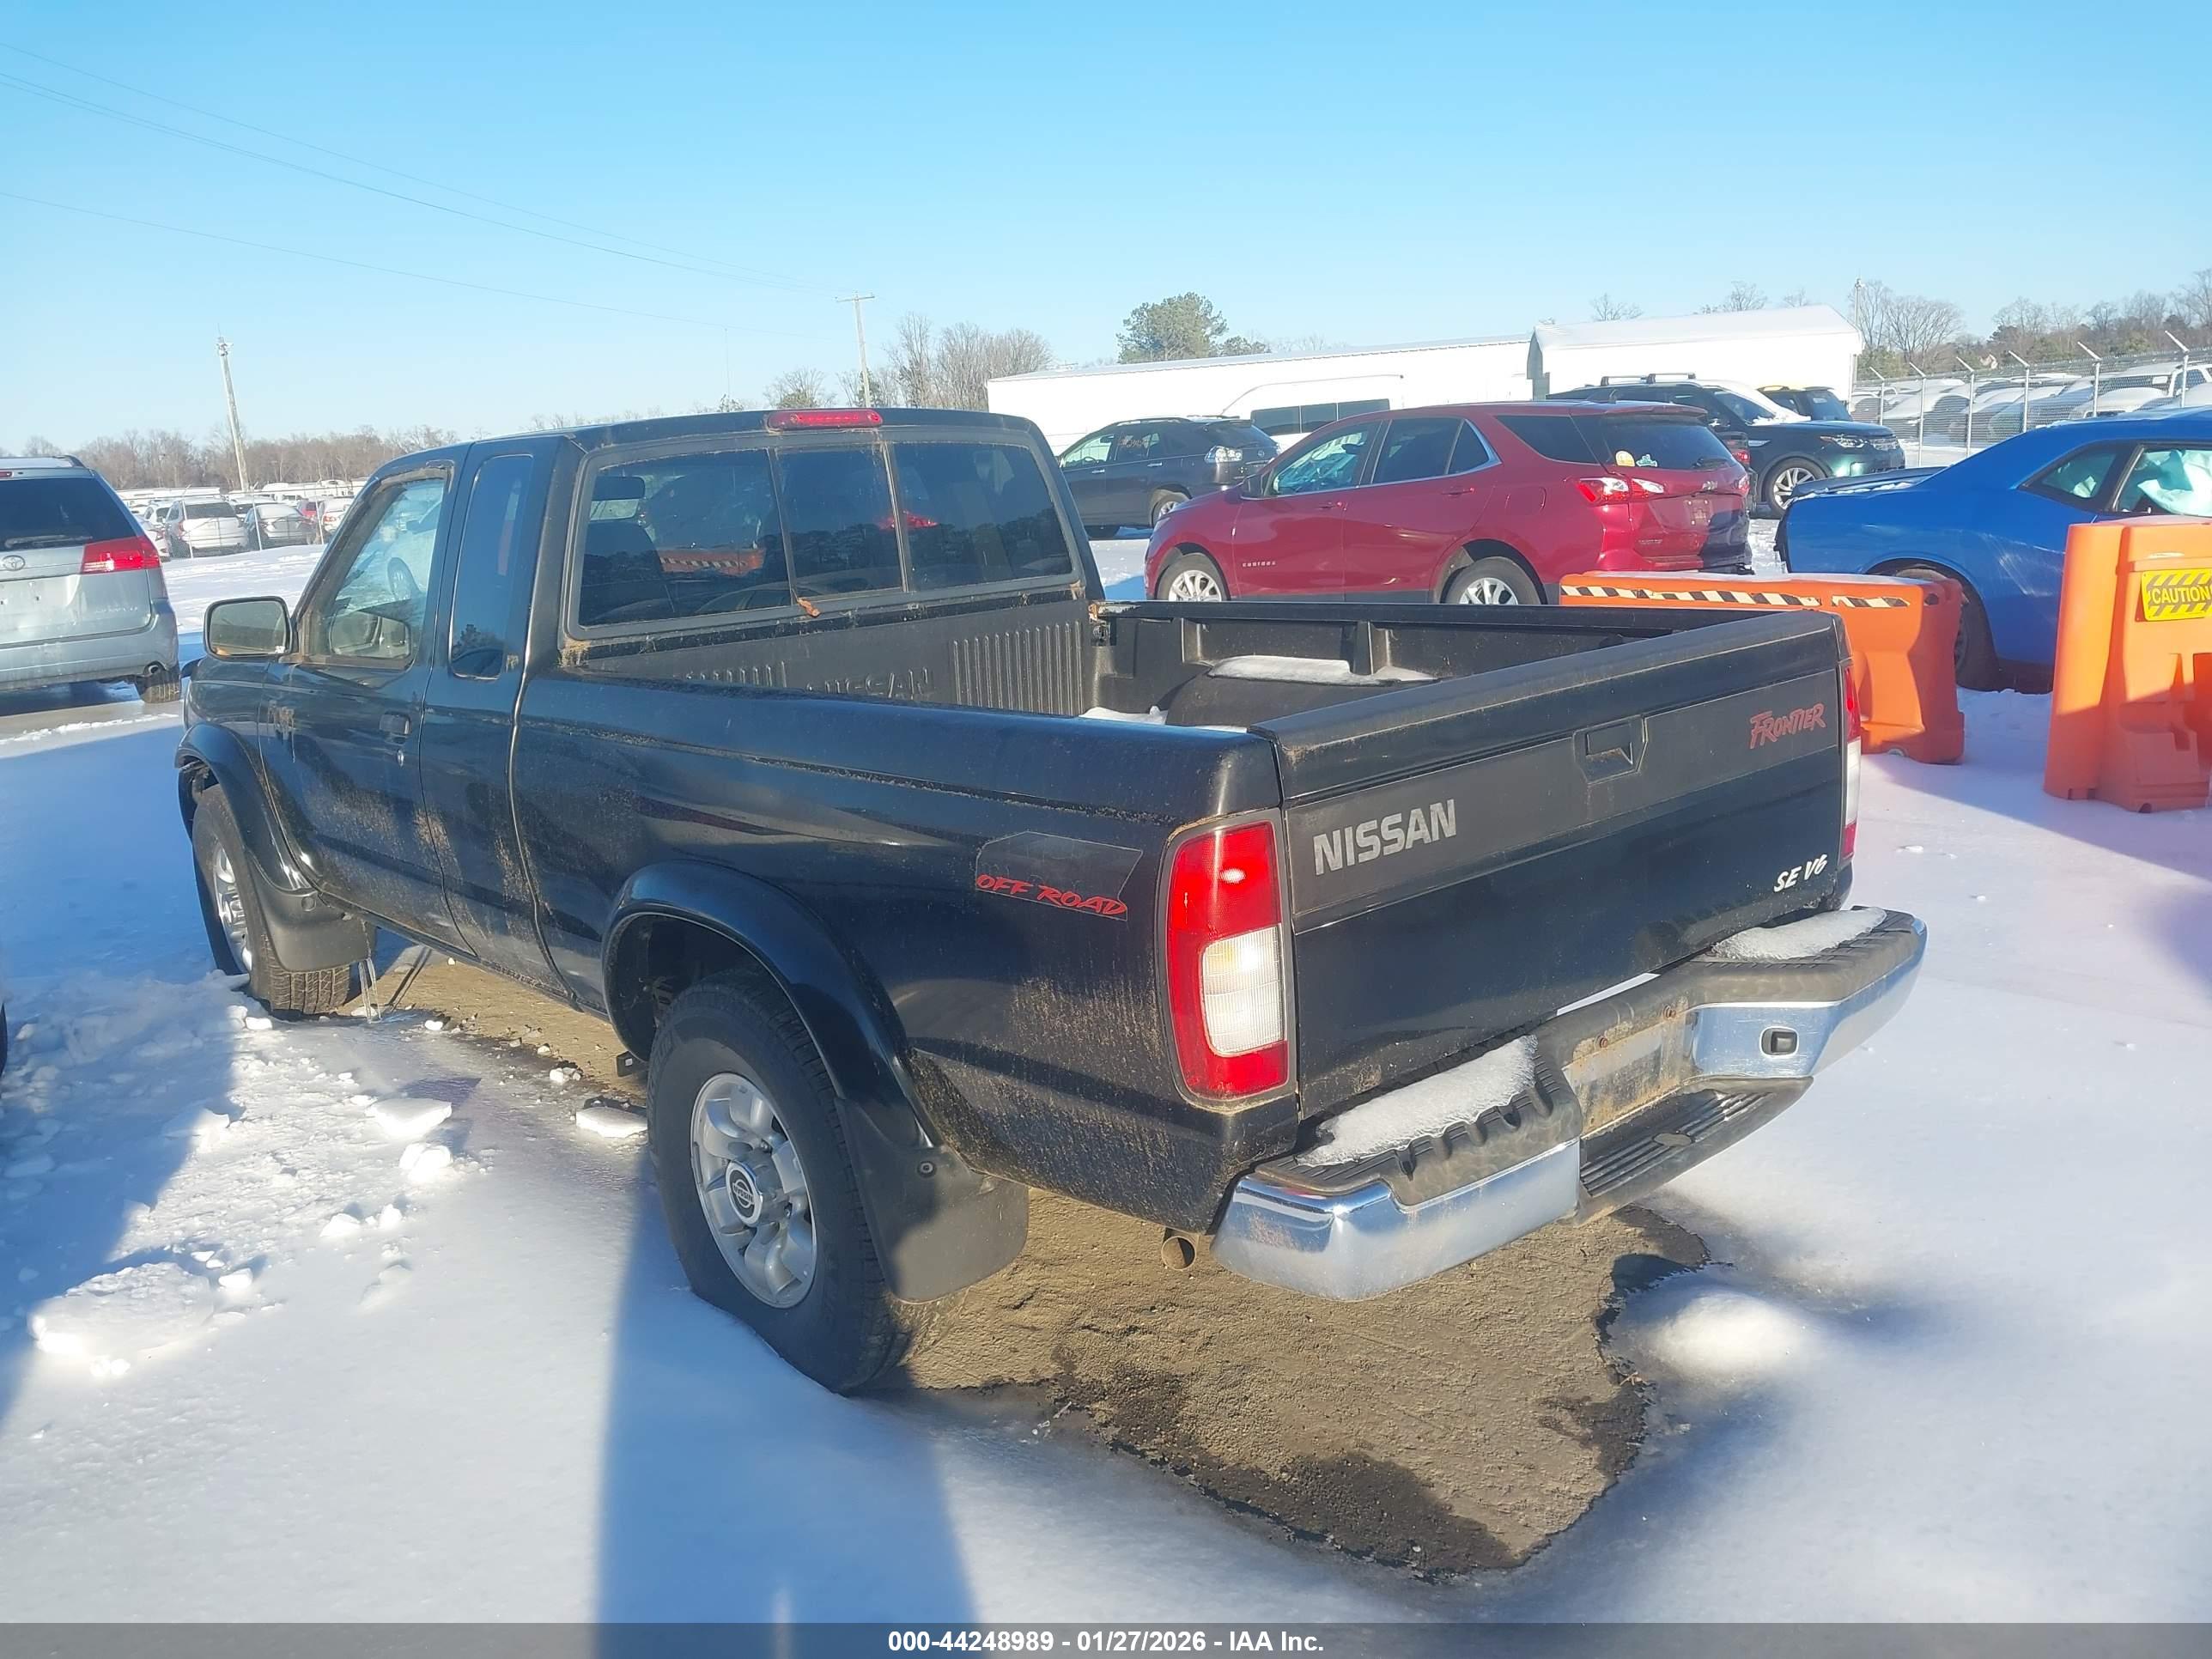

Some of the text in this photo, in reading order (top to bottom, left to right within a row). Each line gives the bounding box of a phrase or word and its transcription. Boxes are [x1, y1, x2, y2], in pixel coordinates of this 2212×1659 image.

[2152, 586, 2211, 604] CAUTION
[1750, 702, 1826, 750] FRONTIER
[1313, 799, 1456, 876] NISSAN
[1773, 854, 1827, 892] SE V6
[976, 874, 1127, 915] OFF ROAD
